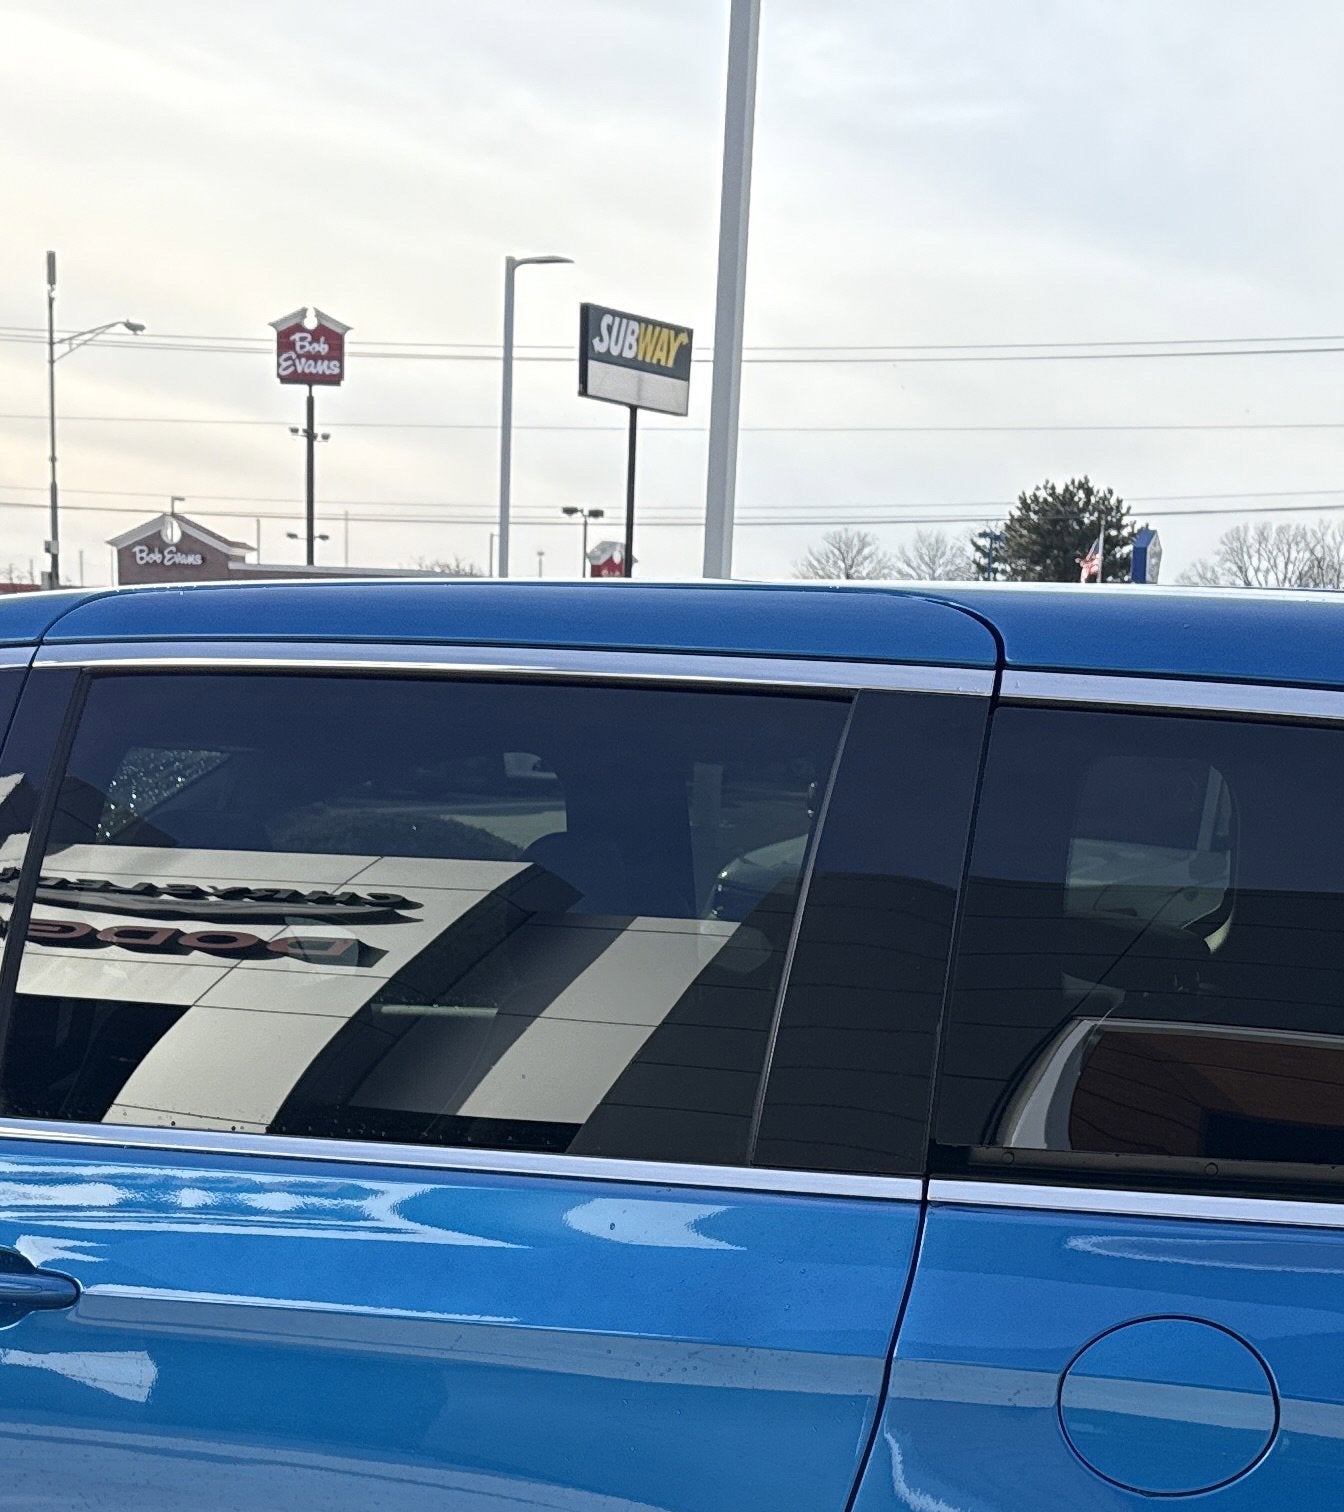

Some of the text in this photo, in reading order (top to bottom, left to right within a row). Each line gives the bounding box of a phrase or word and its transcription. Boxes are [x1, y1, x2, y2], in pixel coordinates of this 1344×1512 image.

[289, 332, 329, 355] Bob
[592, 313, 689, 368] SUBWAY
[278, 351, 340, 375] Evans
[132, 545, 202, 566] Bob Evans
